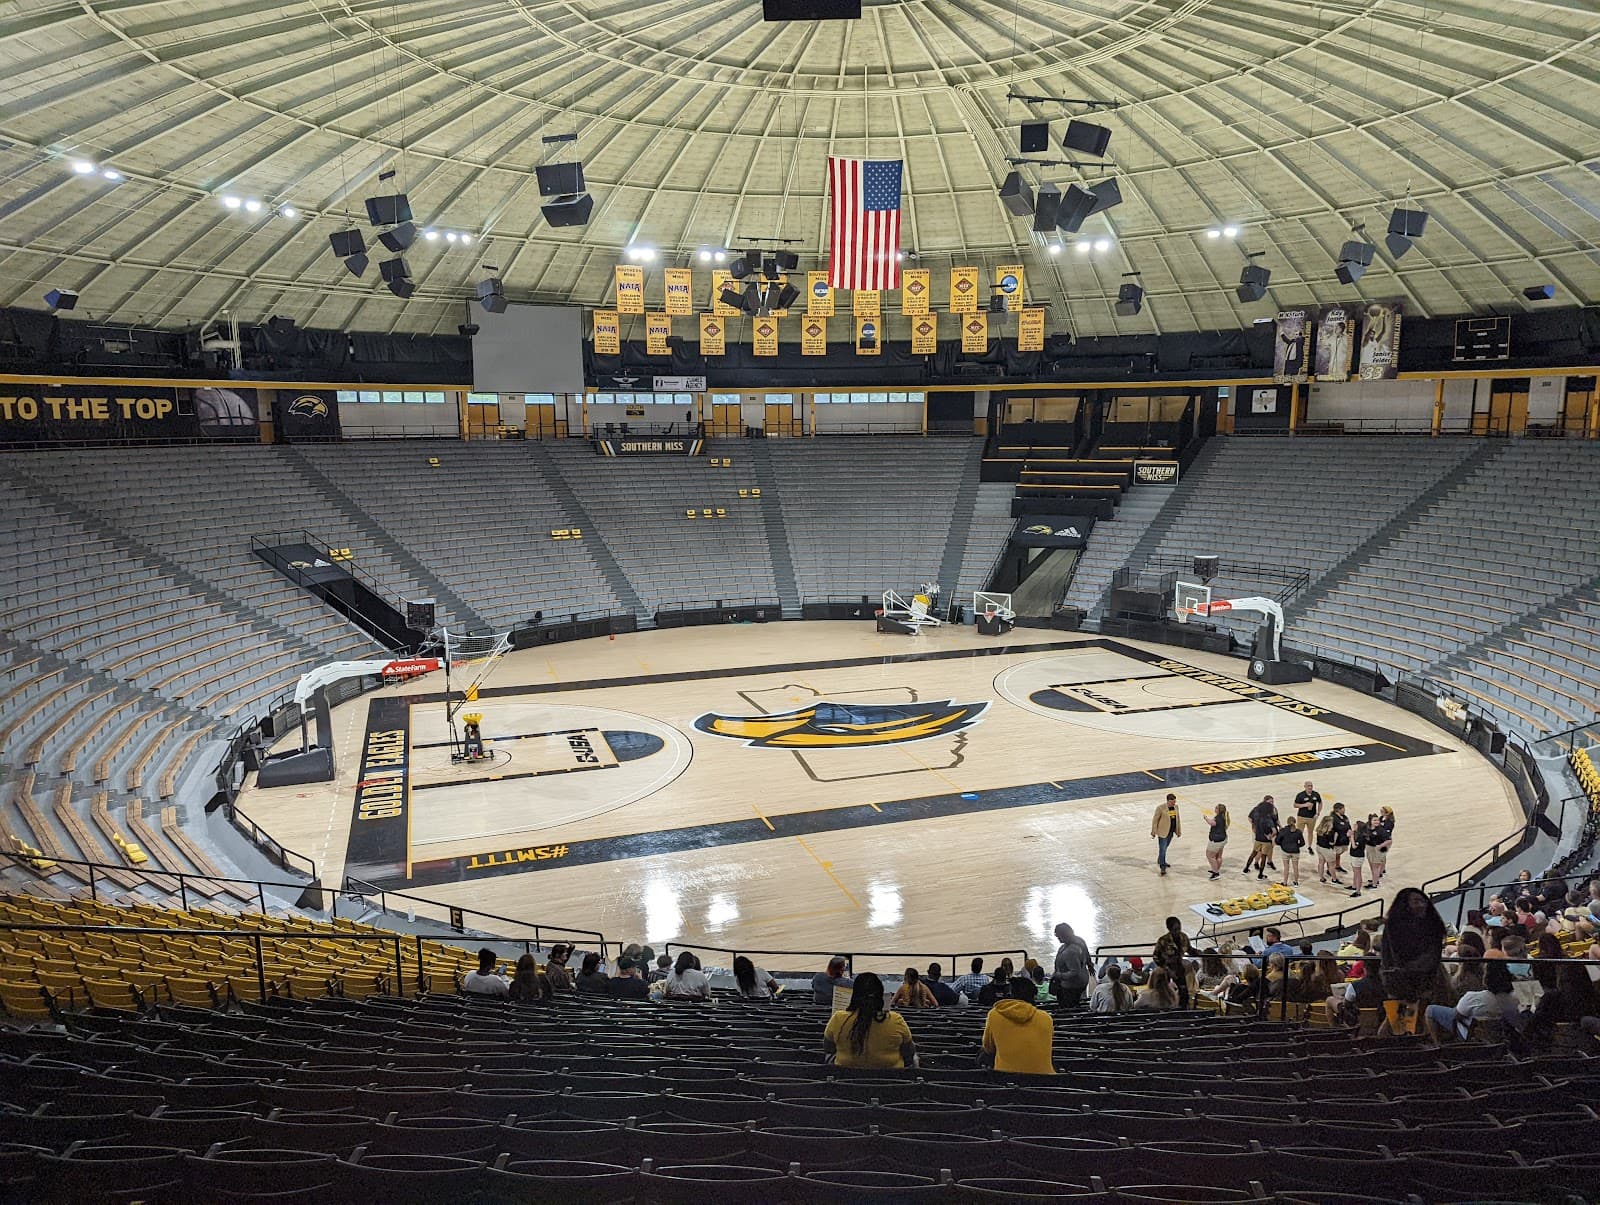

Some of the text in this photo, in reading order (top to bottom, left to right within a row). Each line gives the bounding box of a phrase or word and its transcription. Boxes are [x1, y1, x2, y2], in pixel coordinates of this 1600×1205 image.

[618, 282, 641, 292] NAIA
[668, 285, 689, 294] NAIA
[596, 325, 617, 334] NAIA
[649, 327, 669, 335] NAIA
[0, 397, 173, 420] TO THE TOP
[620, 442, 684, 451] SOUTHERN MISS
[1137, 466, 1176, 475] SOUTHERN
[1148, 660, 1266, 695] SOUTHERN
[1264, 695, 1332, 716] MISS
[358, 729, 405, 820] GOLDEN EAGLES
[466, 845, 569, 869] #SMTTT
